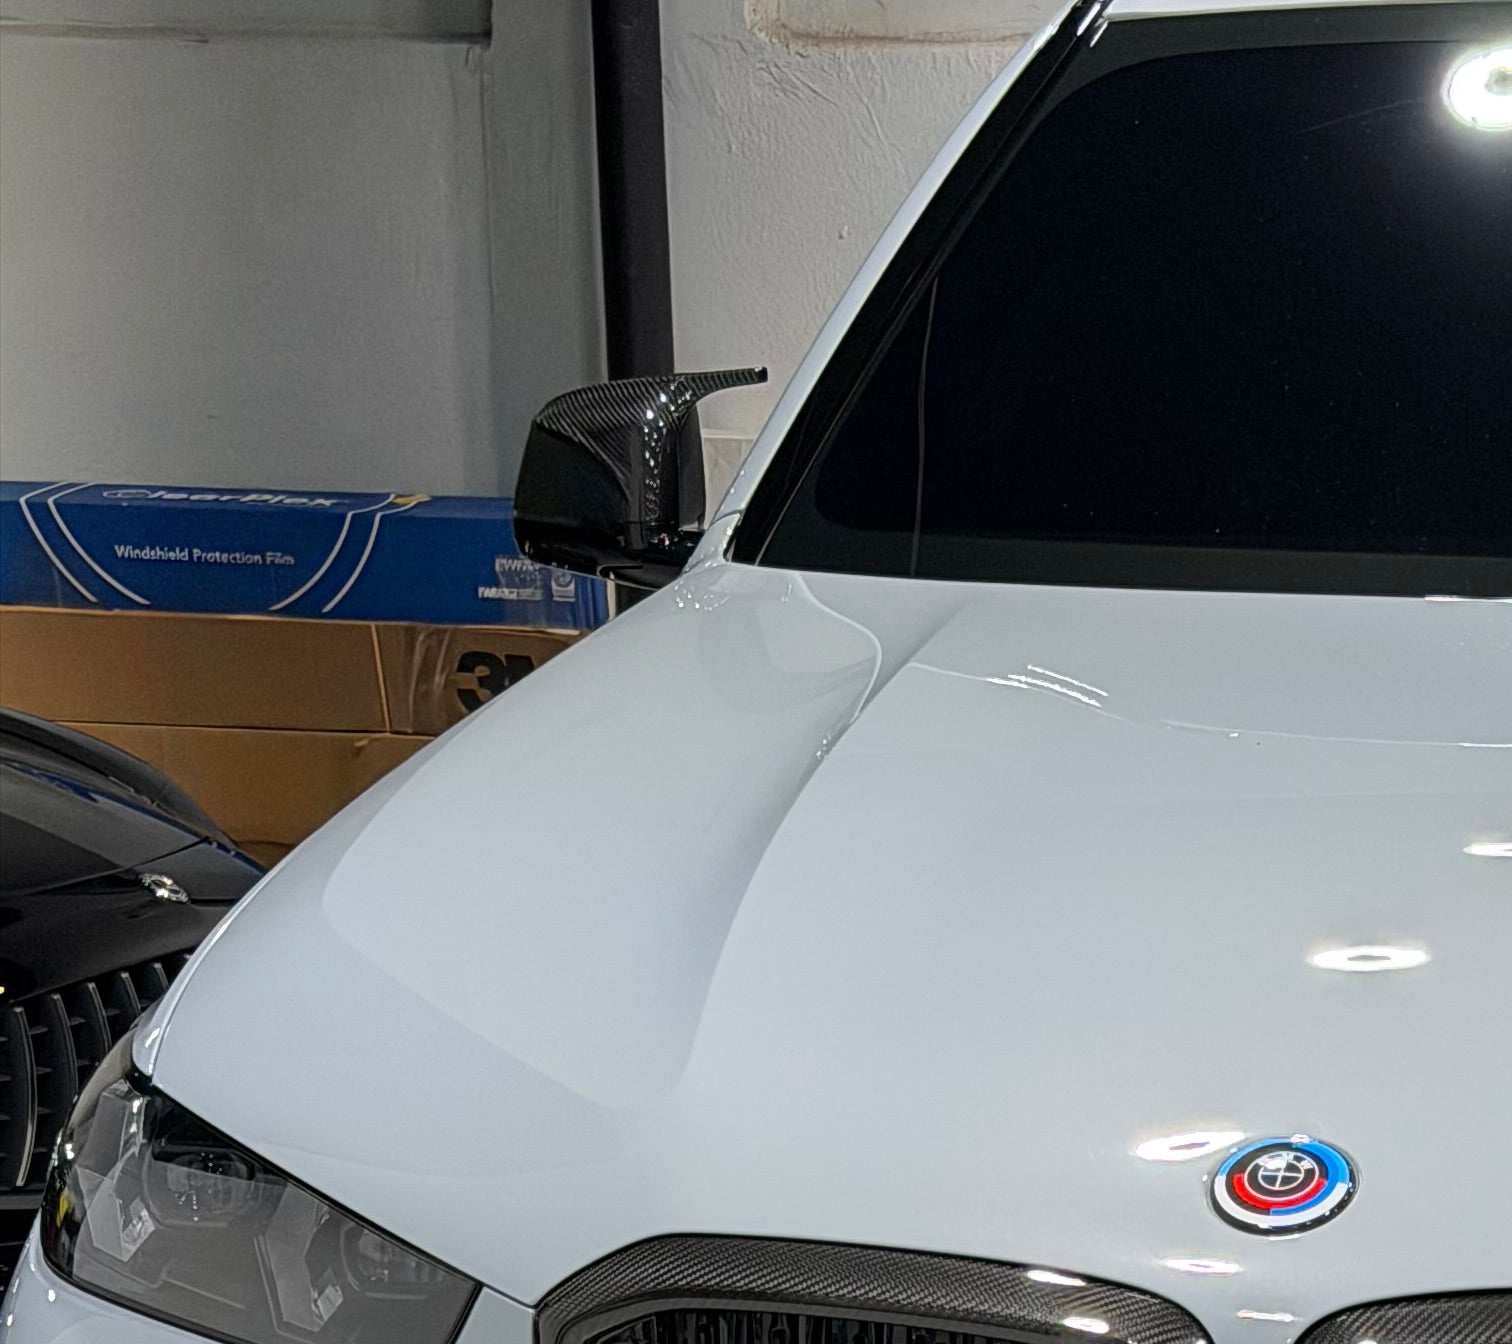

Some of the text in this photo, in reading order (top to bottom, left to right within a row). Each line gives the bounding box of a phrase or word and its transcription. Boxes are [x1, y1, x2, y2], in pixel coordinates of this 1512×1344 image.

[114, 544, 295, 566] Windshield Protection Film
